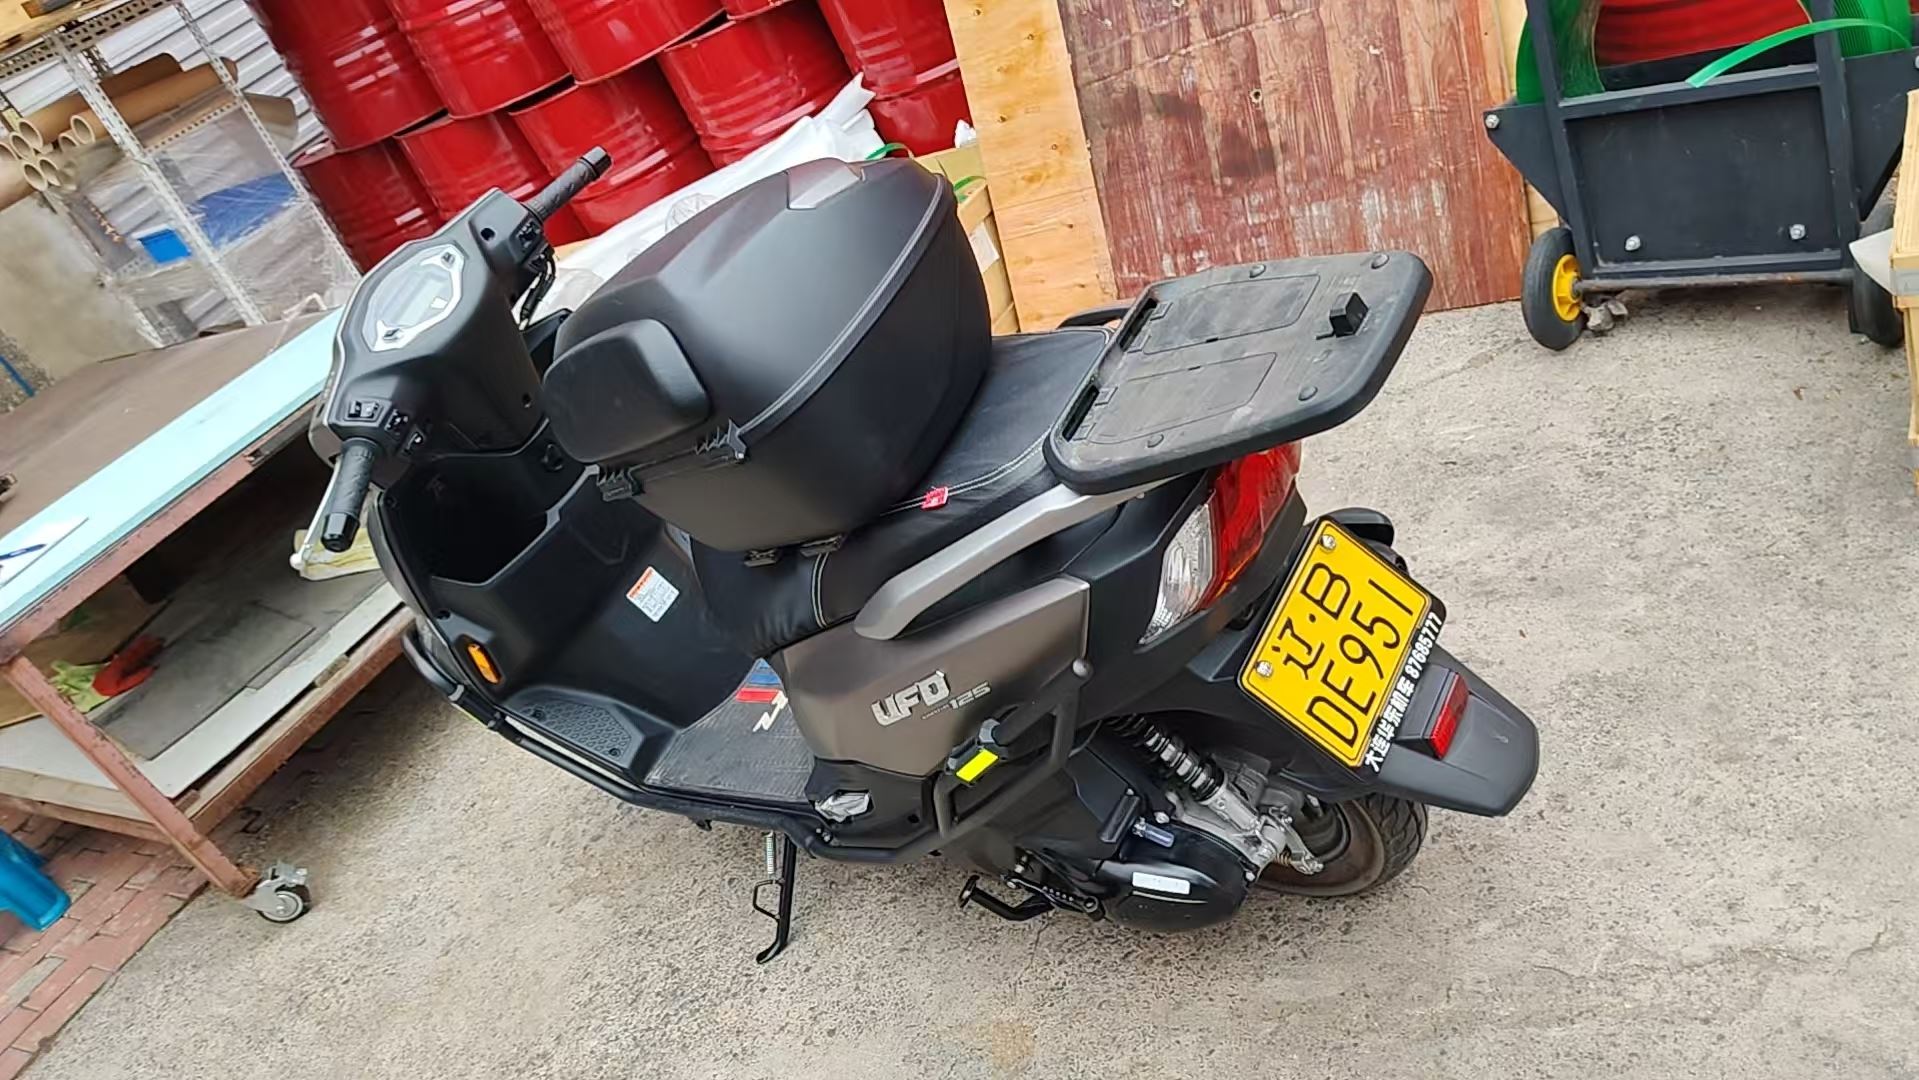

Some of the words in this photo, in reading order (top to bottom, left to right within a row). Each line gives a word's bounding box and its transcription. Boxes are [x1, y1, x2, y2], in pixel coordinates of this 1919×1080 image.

[1307, 579, 1413, 748] DE951
[1404, 611, 1443, 678] 87685777
[950, 681, 992, 710] 125
